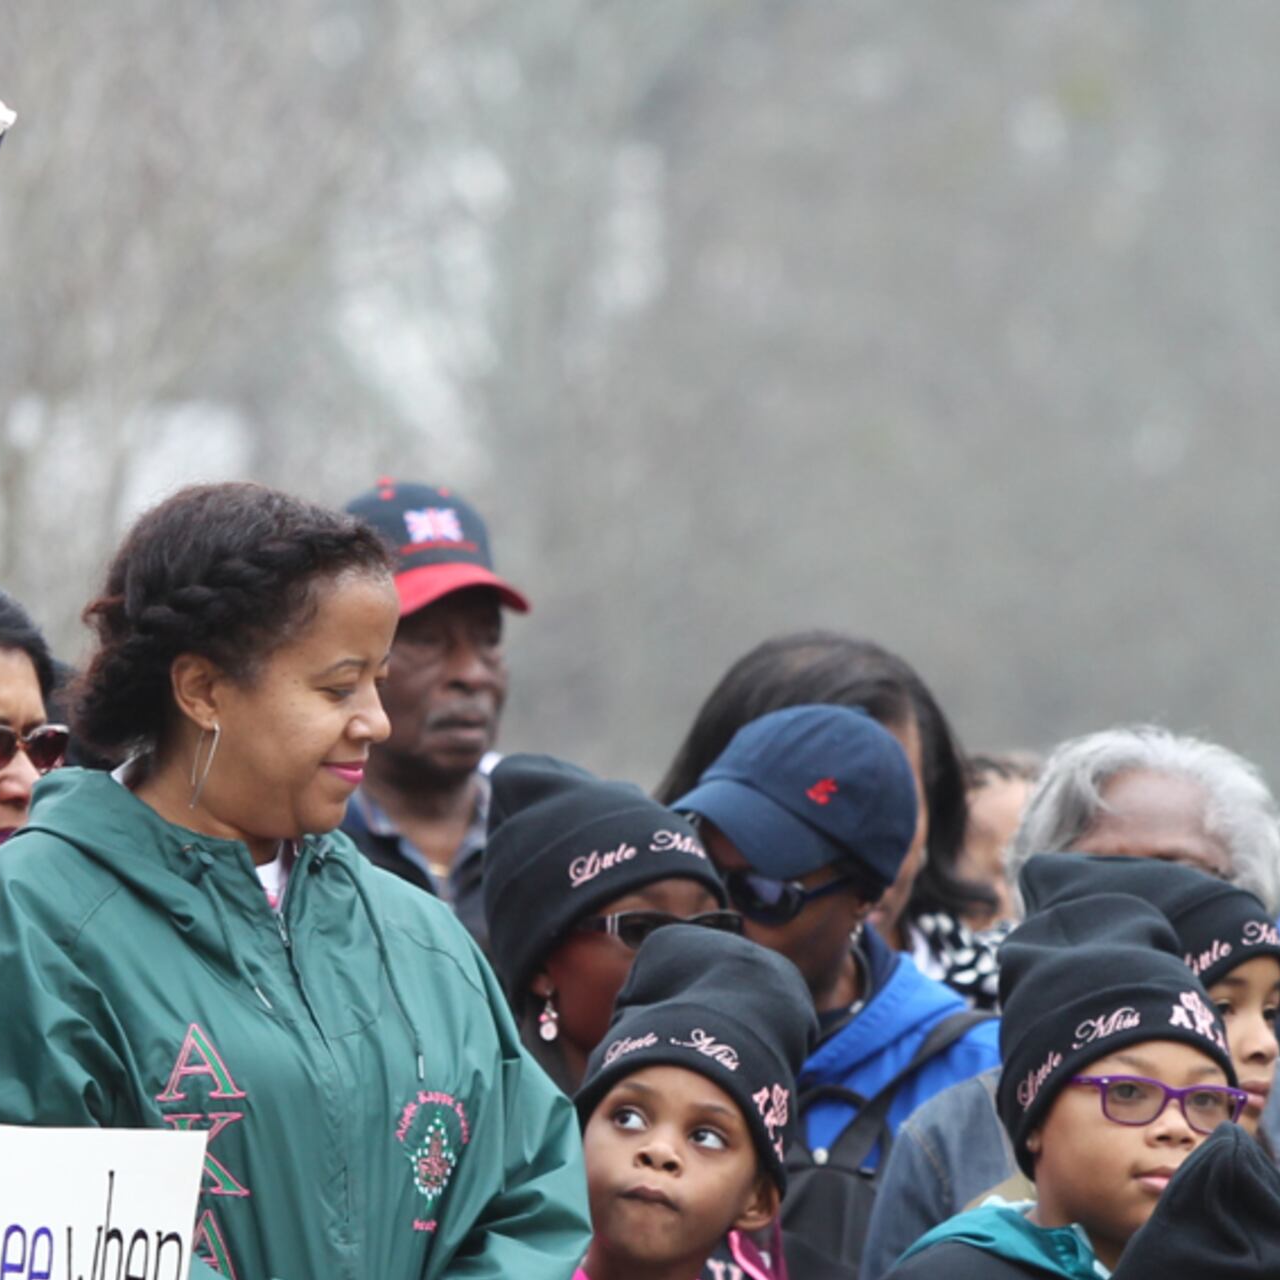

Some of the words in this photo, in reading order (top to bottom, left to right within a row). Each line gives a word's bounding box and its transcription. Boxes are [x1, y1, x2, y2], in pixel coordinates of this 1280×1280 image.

[569, 842, 638, 889] Little
[1184, 940, 1233, 977] ittle
[602, 1031, 659, 1069] Little
[669, 1027, 740, 1072] Miss
[1016, 1051, 1063, 1113] Little
[1071, 1006, 1141, 1051] Miss
